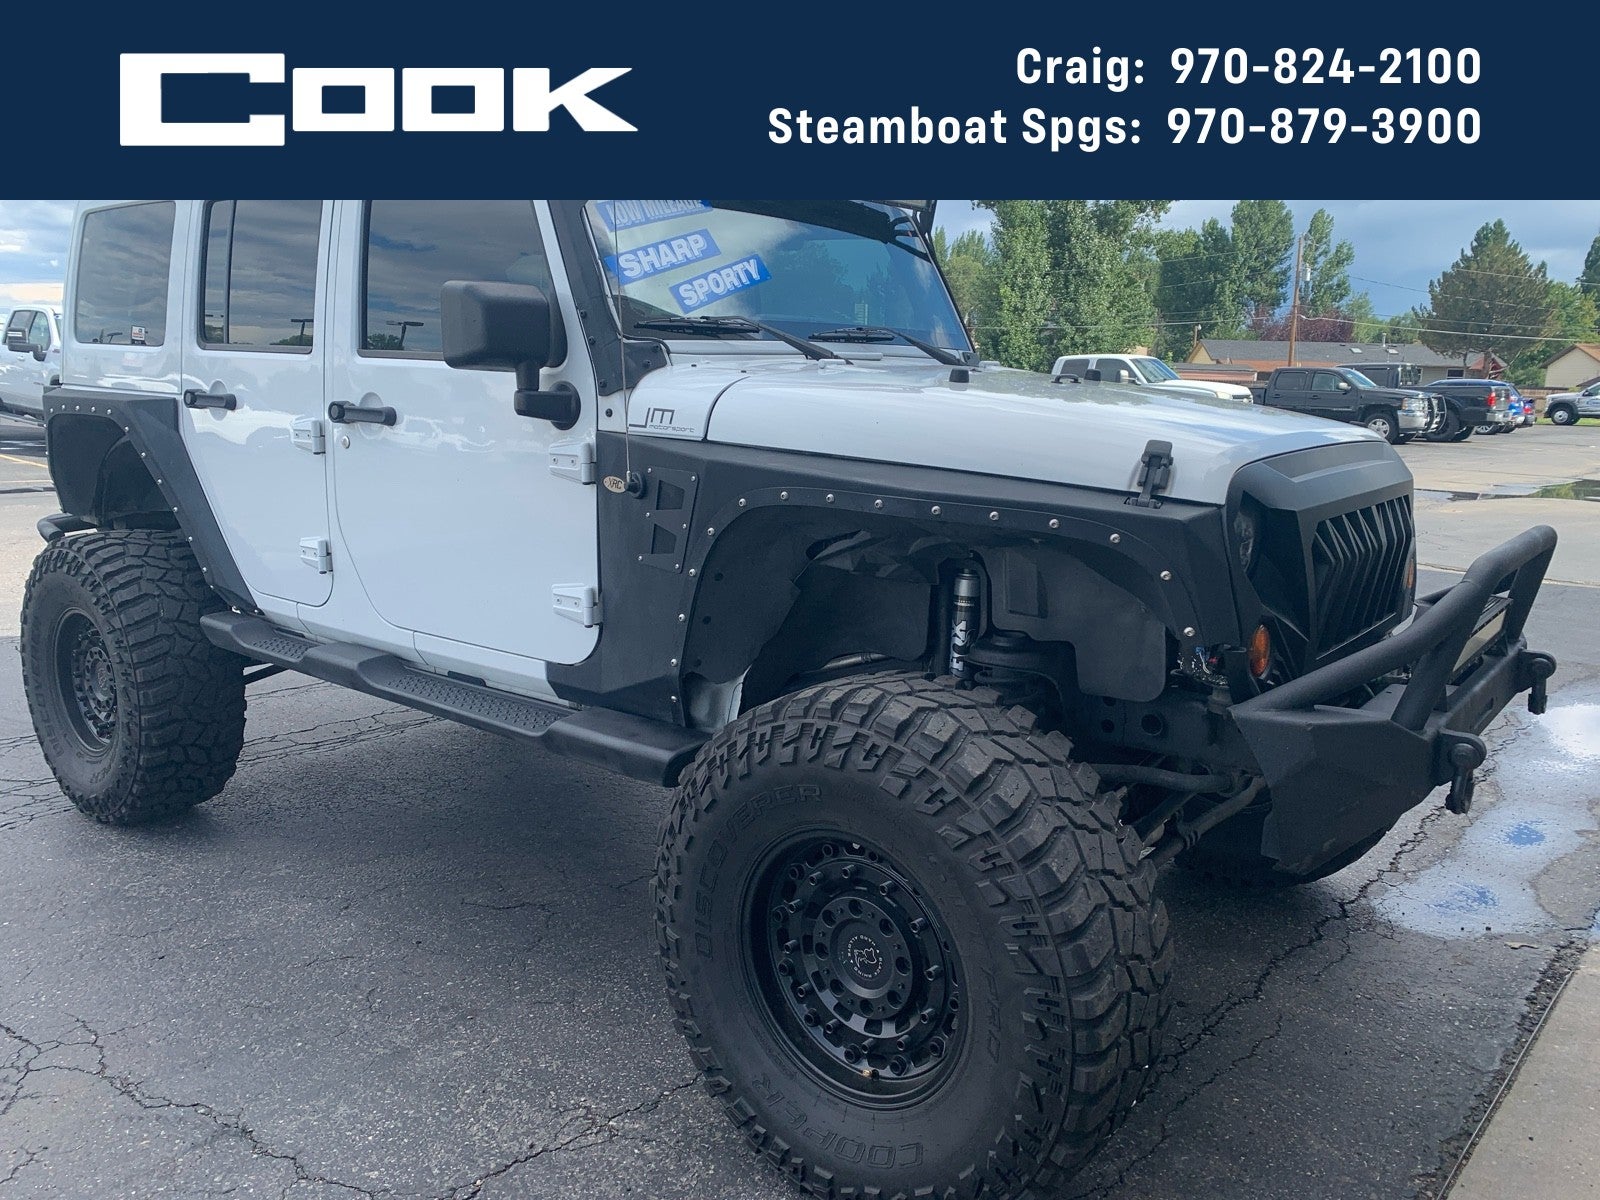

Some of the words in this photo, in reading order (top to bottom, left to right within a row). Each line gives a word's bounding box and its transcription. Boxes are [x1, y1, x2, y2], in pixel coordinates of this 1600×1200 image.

[618, 234, 707, 278] SHARP
[678, 258, 760, 307] SPORTY
[694, 784, 823, 960] DISCOVERER
[752, 1072, 924, 1170] COOPER
